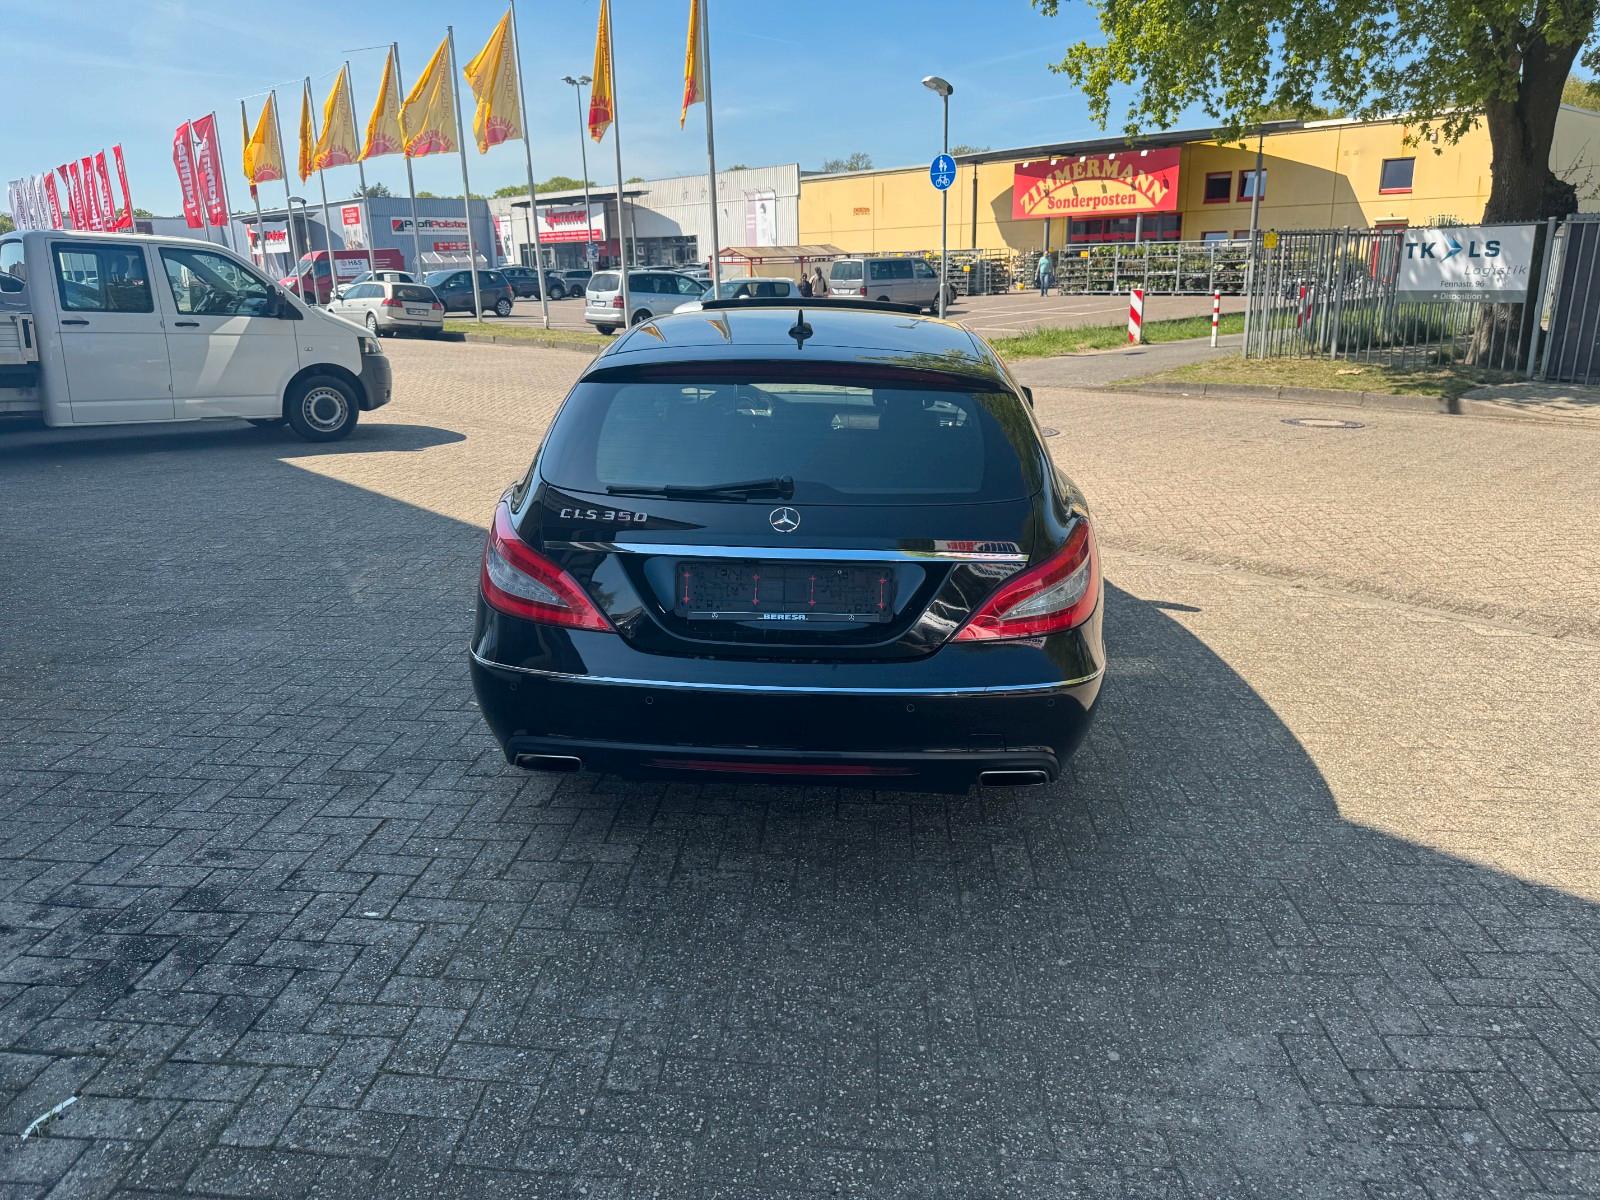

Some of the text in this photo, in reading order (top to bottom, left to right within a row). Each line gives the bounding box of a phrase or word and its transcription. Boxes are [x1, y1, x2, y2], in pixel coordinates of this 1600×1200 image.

[1020, 159, 1169, 214] ZIMMERMANN
[1047, 192, 1136, 209] Sonderposten
[1464, 263, 1527, 278] Logistik
[1440, 292, 1482, 300] Disposition
[560, 508, 648, 522] CLS 350
